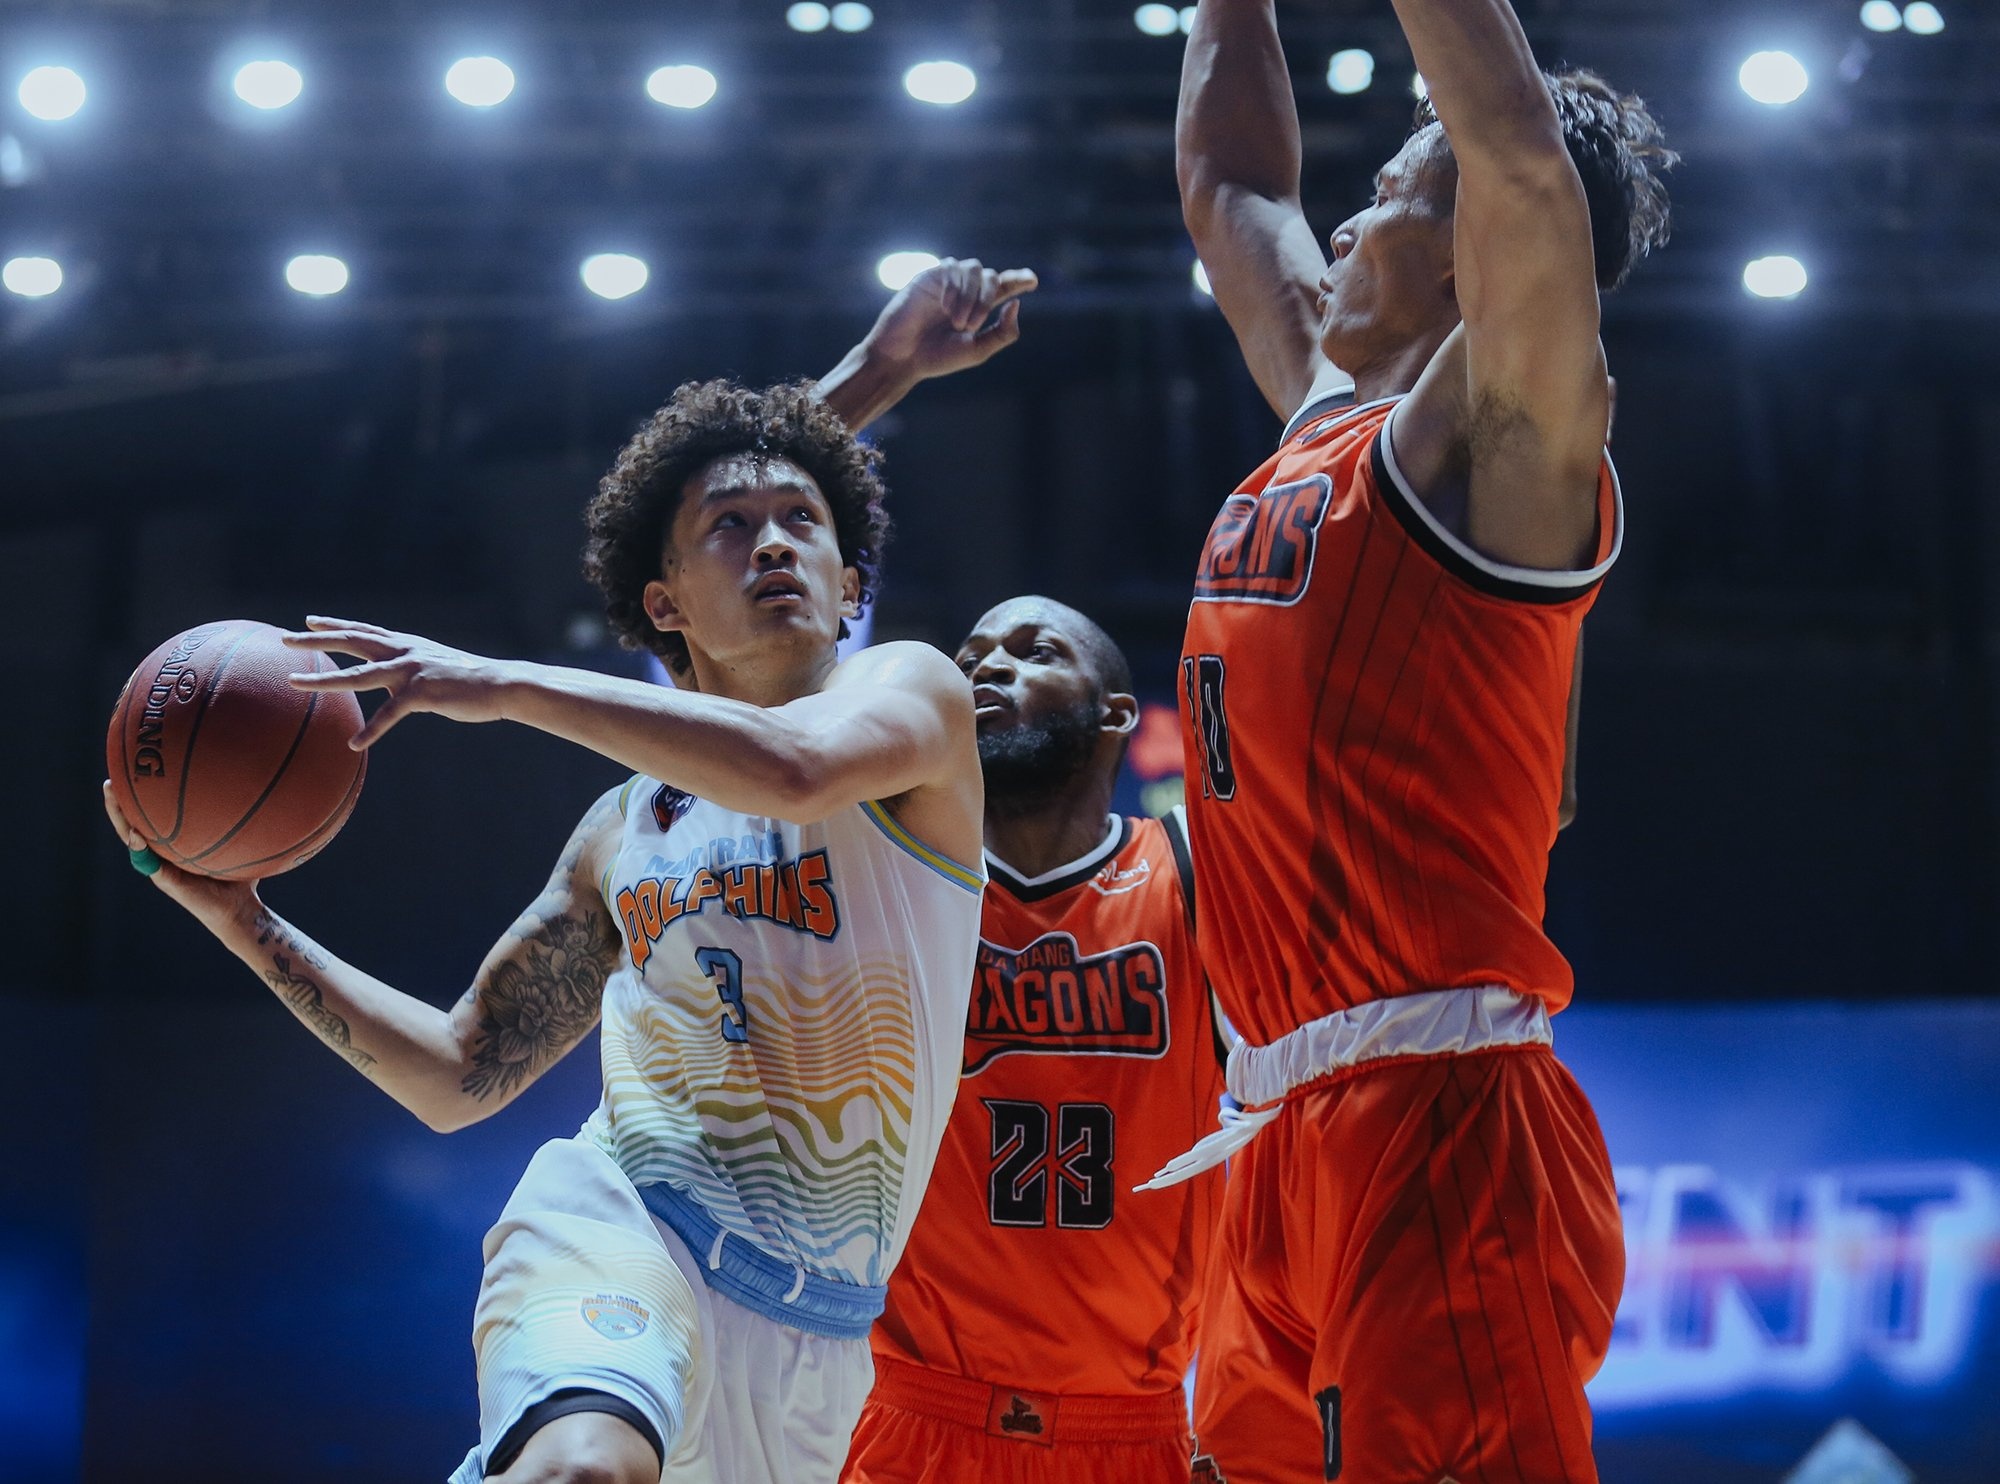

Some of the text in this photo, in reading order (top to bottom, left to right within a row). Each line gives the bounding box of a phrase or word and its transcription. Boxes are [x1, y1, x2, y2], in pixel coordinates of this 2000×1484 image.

[133, 625, 227, 778] SPALDING
[616, 846, 841, 983] DOLPHINS
[1016, 943, 1071, 971] NANG
[694, 946, 750, 1043] 3
[979, 1097, 1115, 1230] 23
